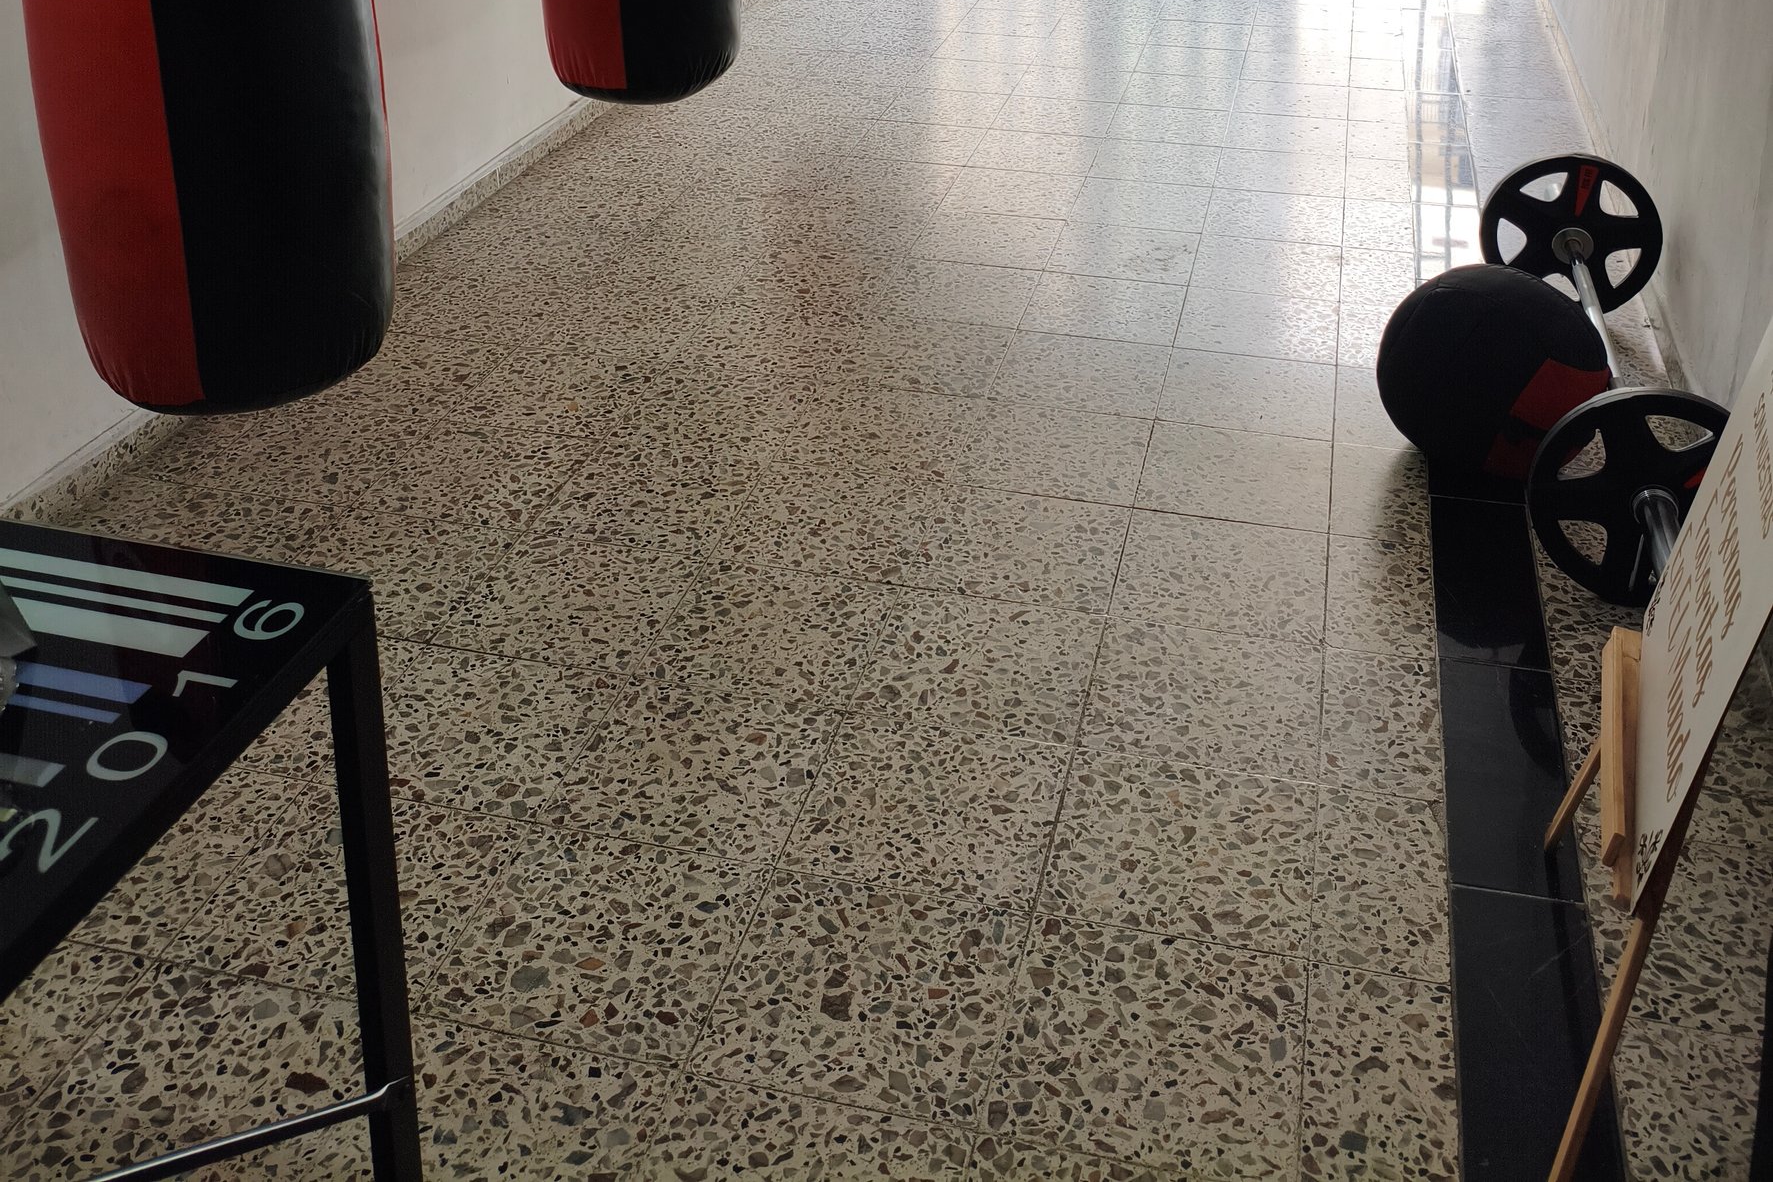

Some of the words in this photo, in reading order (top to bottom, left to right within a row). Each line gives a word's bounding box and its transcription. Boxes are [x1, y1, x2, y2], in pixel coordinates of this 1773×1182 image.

[1754, 392, 1767, 443] SON
[1756, 428, 1773, 540] NUESTRAS
[1669, 521, 1692, 606] En
[1691, 487, 1719, 708] Favoritas
[1718, 433, 1744, 641] Personas
[1667, 626, 1692, 804] Mundo
